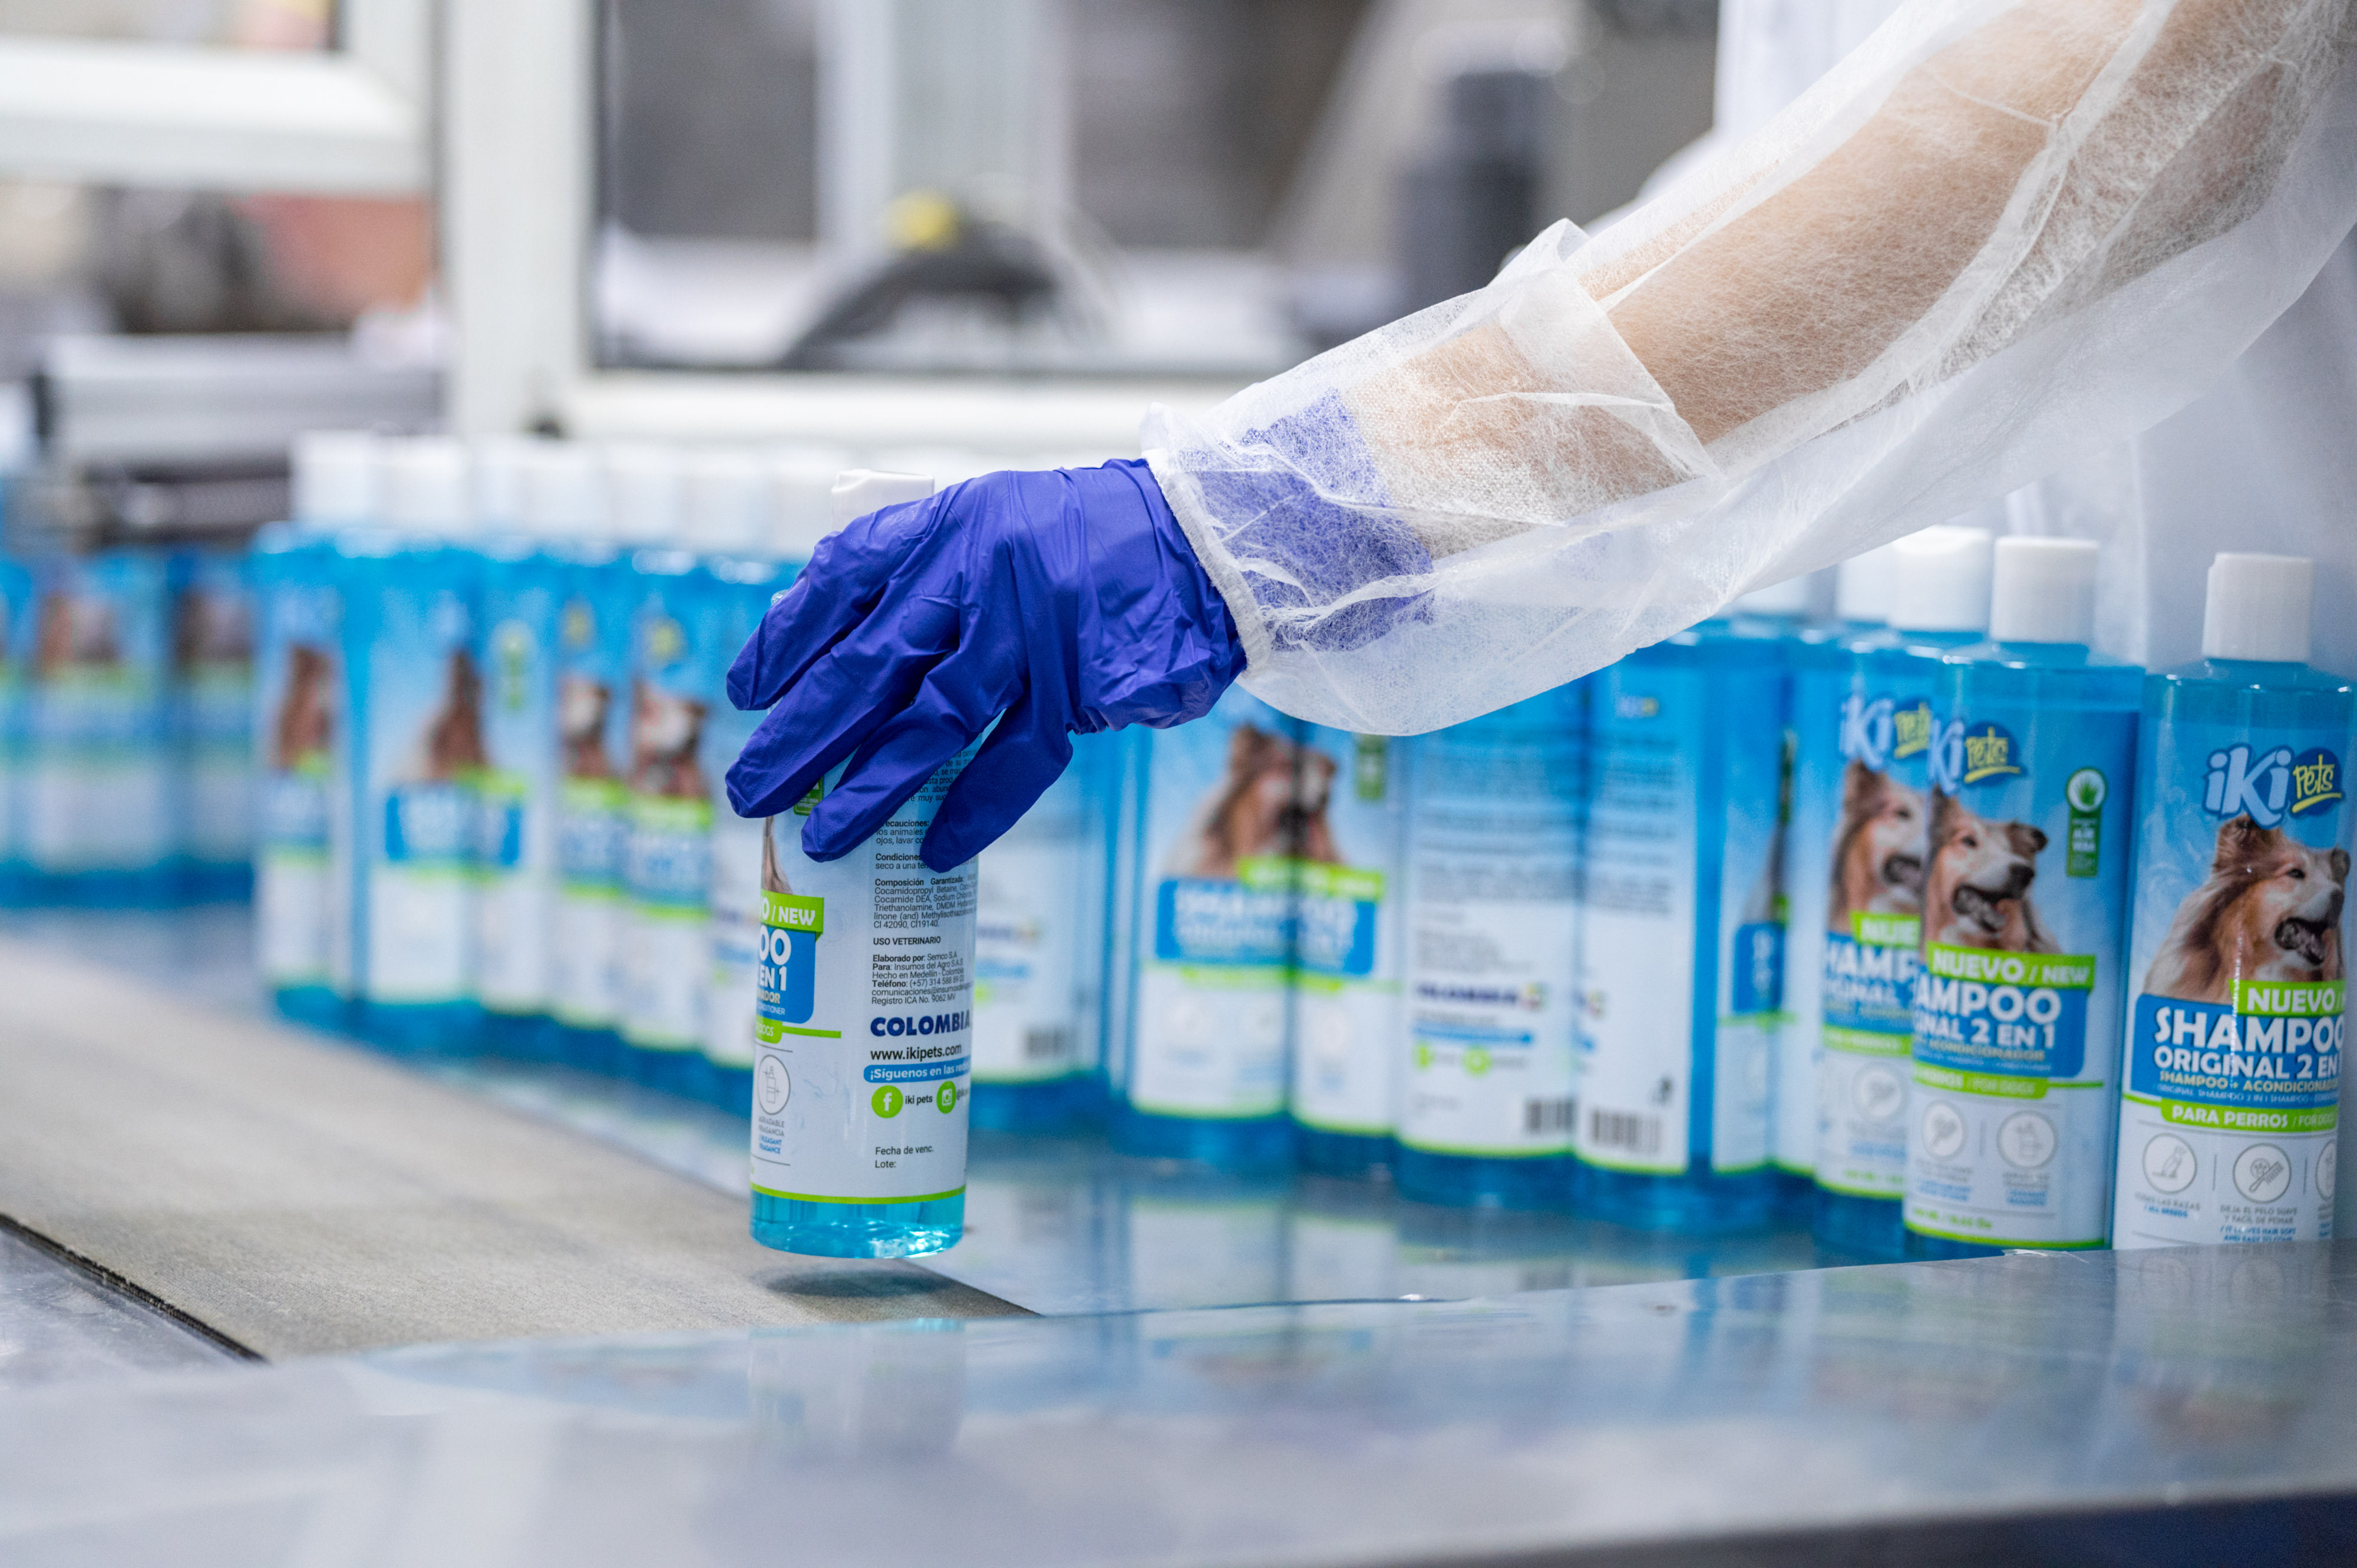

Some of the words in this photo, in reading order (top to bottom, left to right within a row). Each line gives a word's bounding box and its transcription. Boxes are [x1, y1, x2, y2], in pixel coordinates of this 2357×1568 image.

[918, 795, 933, 803] muy
[876, 836, 894, 846] ojos,
[875, 878, 924, 888] Composición
[874, 886, 933, 896] Cocamidopropyl
[874, 895, 914, 903] Cocamide
[933, 893, 955, 902] Sodium
[874, 903, 933, 912] Triethanolamine,
[936, 902, 956, 910] DMDM
[778, 906, 816, 926] NEW
[900, 912, 919, 921] (and)
[883, 920, 909, 929] 42090,
[893, 936, 941, 945] VETERINARIO
[912, 955, 926, 963] por:
[927, 953, 948, 961] Semco
[873, 963, 892, 971] Para:
[937, 961, 950, 969] Agro
[1932, 949, 2024, 982] NUEVO
[759, 964, 775, 989] EN
[778, 966, 787, 991] 1
[872, 971, 897, 979] Hecho
[910, 979, 927, 989] (+57)
[872, 997, 903, 1006] Registro
[932, 994, 946, 1002] 9062
[2246, 988, 2335, 1014] NUEVO
[870, 1010, 970, 1036] COLOMBIA
[1970, 1018, 1990, 1044] 2
[1997, 1024, 2036, 1047] EN
[2044, 1024, 2055, 1049] 1
[2154, 1006, 2345, 1054] SHAMPOO
[870, 1044, 962, 1061] www.ikipets.com
[2154, 1045, 2289, 1079] ORIGINAL
[2296, 1054, 2313, 1078] 2
[2317, 1054, 2338, 1079] EN
[870, 1068, 927, 1081] ¡Síguenos
[944, 1065, 955, 1075] las
[2160, 1069, 2228, 1090] SHAMPOO
[905, 1095, 914, 1104] iki
[917, 1095, 933, 1105] pets
[2172, 1105, 2219, 1126] PARA
[2224, 1110, 2288, 1128] PERROS
[875, 1146, 901, 1155] Fecha
[903, 1146, 913, 1154] de
[875, 1160, 896, 1168] Lote:
